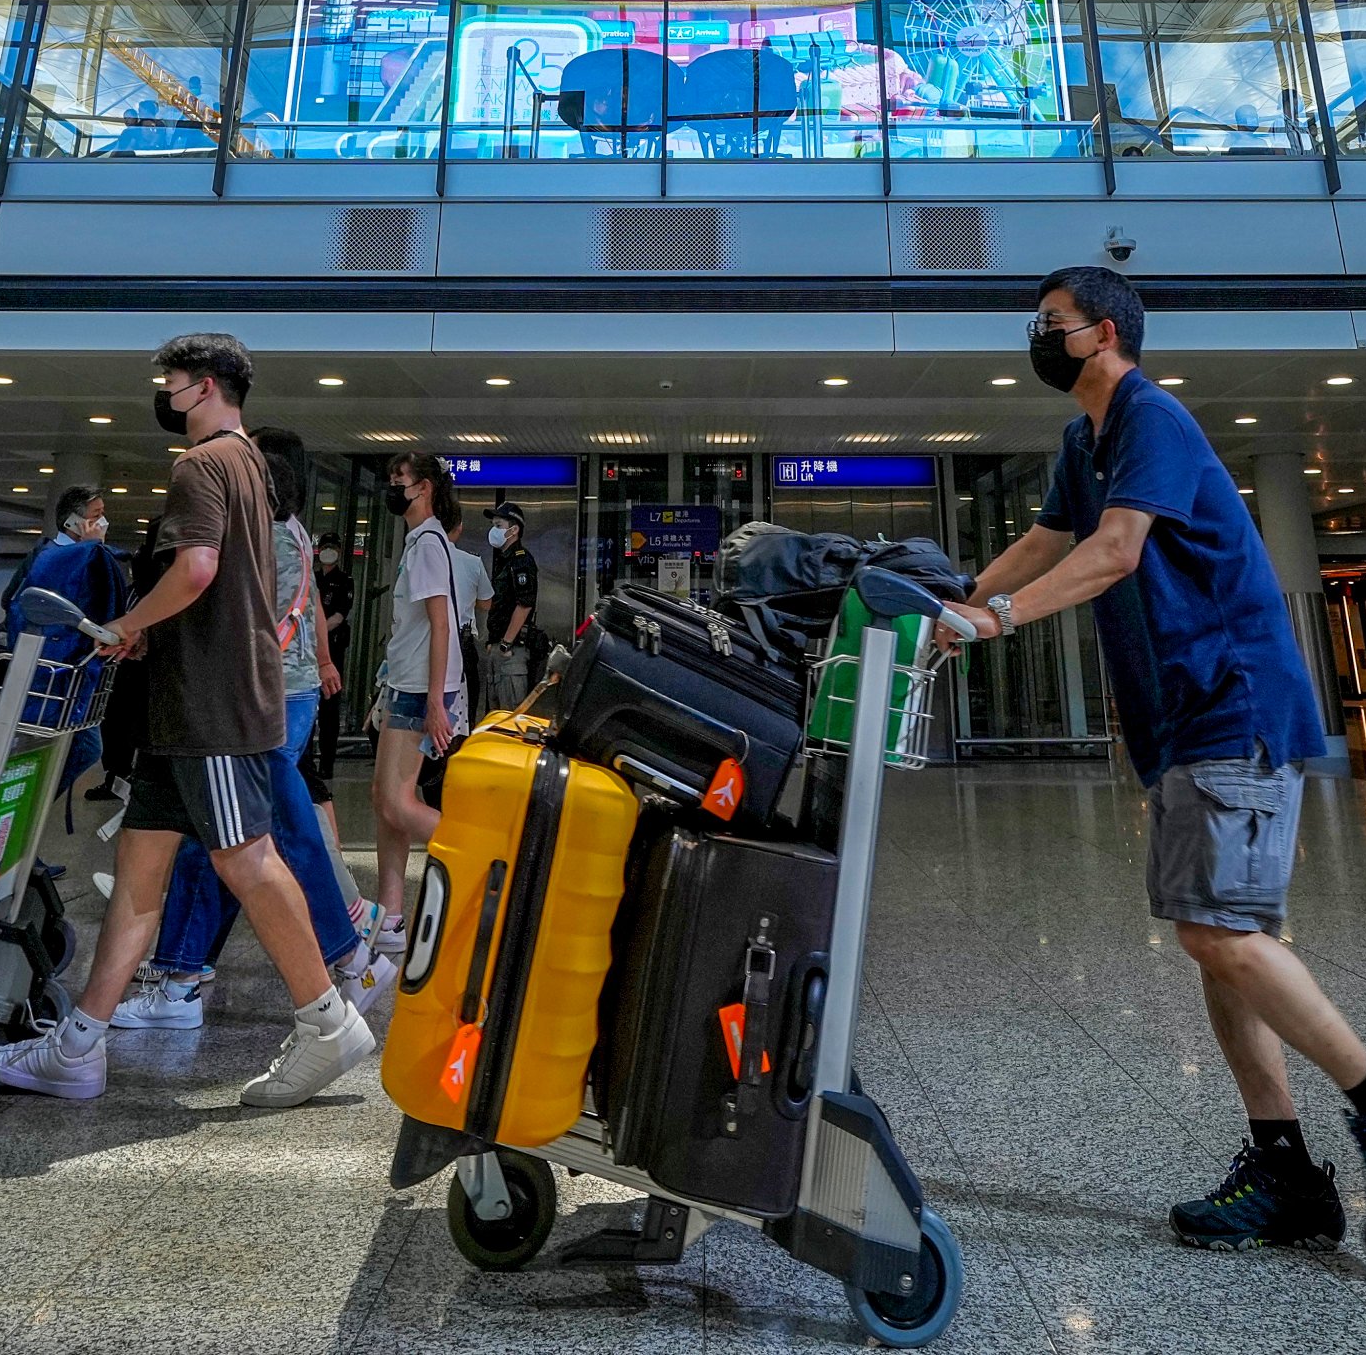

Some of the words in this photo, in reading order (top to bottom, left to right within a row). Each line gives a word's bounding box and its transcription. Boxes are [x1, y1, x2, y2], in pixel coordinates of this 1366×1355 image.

[801, 460, 838, 473] 升降機
[801, 473, 814, 482] Lift
[650, 512, 661, 522] L7
[650, 536, 661, 546] L5
